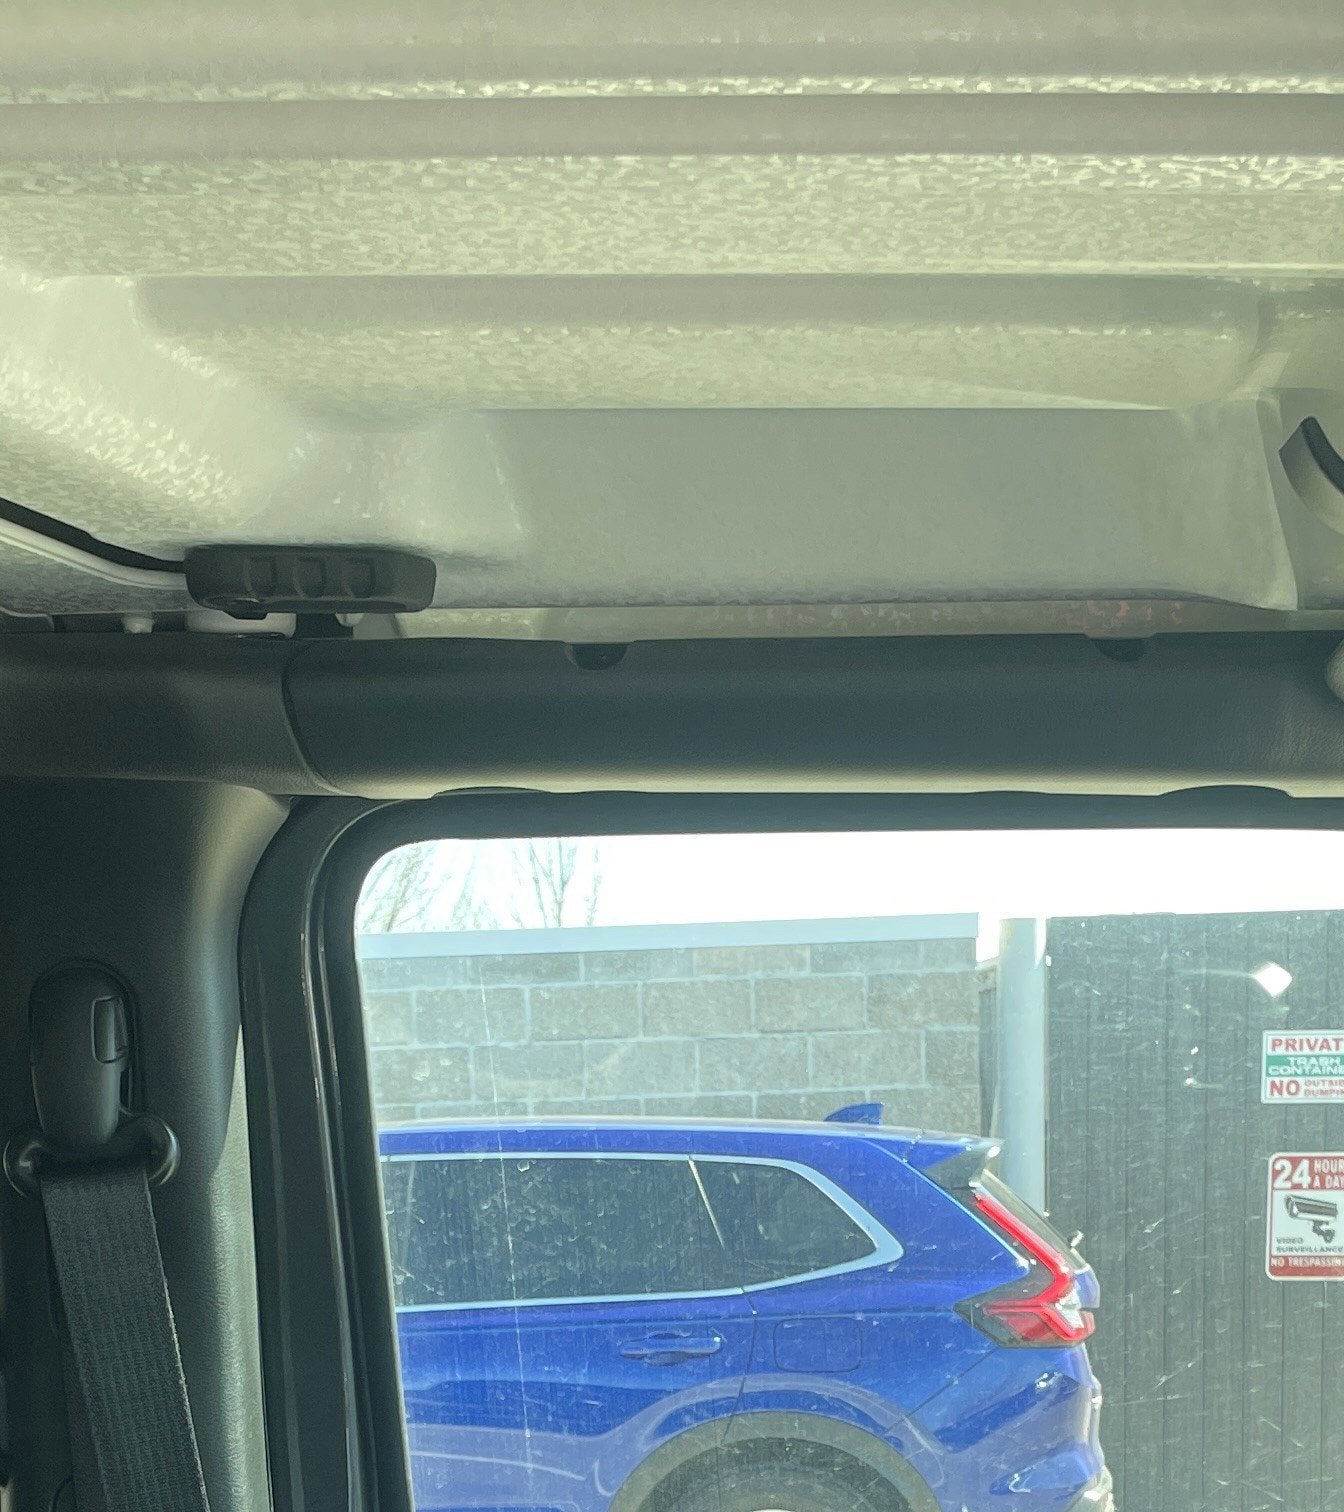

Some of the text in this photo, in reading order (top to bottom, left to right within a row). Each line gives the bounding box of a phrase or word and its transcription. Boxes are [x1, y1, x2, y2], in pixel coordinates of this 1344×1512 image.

[1287, 1056, 1341, 1067] TRASH
[1270, 1079, 1300, 1097] NO
[1273, 1158, 1311, 1189] 24
[1313, 1175, 1321, 1188] A
[1271, 1257, 1284, 1267] NO
